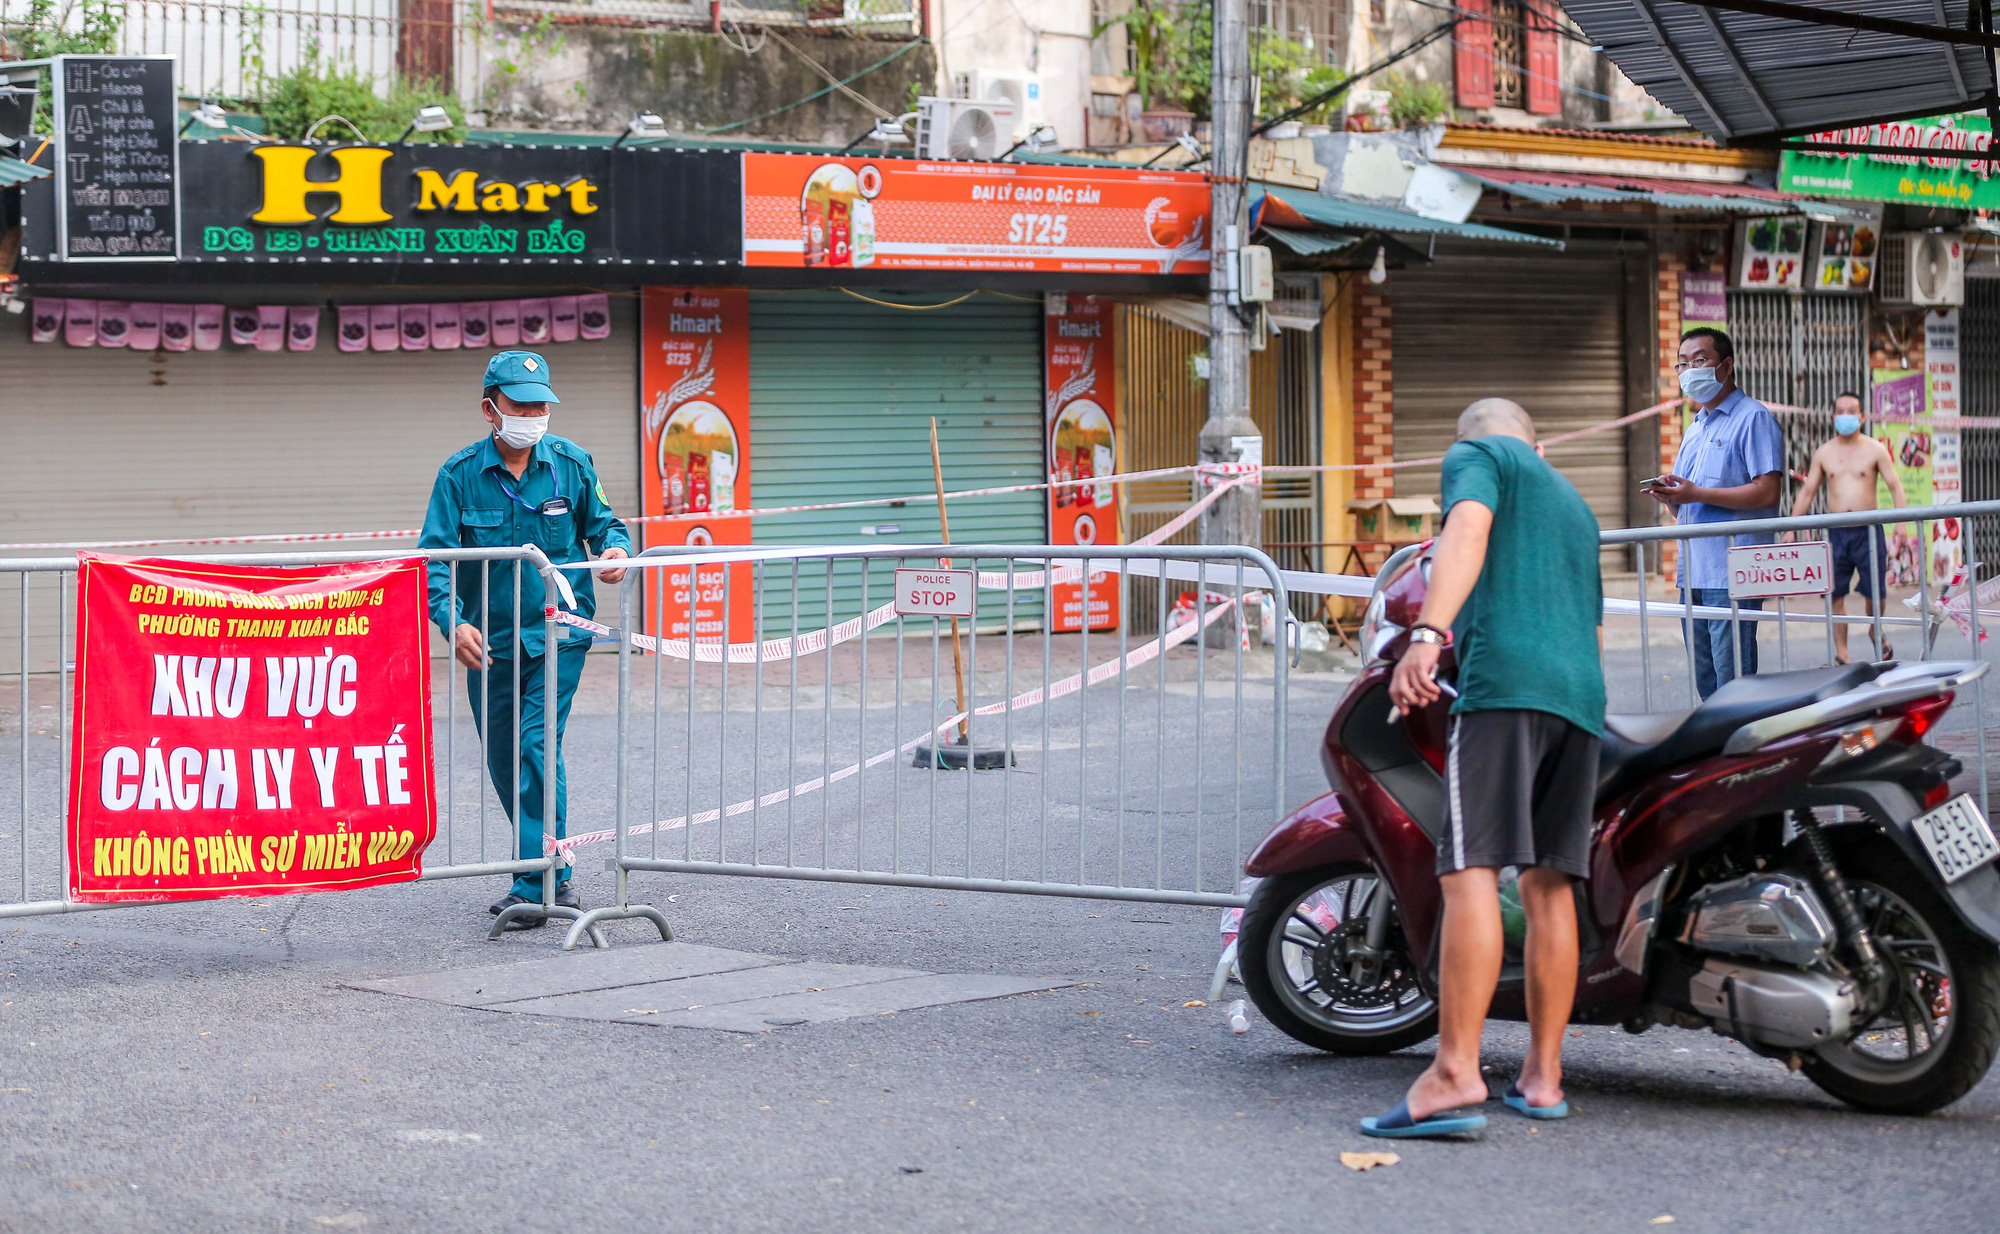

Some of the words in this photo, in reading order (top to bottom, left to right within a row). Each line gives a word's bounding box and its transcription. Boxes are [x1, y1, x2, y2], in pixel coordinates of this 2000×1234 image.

[251, 145, 394, 225] H
[416, 168, 598, 215] Mart
[972, 185, 995, 204] ĐẠI
[997, 182, 1013, 200] LÝ
[1014, 187, 1043, 205] GẠO
[1045, 185, 1074, 207] ĐẶC
[1075, 184, 1101, 204] SẢN
[323, 228, 425, 252] THANH
[435, 222, 518, 253] XUÂN
[527, 219, 586, 253] BẮC
[1008, 212, 1068, 244] ST25
[670, 312, 723, 334] Hmart
[1058, 318, 1103, 338] Hmart
[666, 352, 692, 366] ST25
[1754, 551, 1799, 561] C.A.H.N
[916, 575, 951, 584] POLICE
[1735, 564, 1787, 585] DỪNG
[1790, 565, 1822, 584] LẠI
[129, 583, 168, 605] BCĐ
[172, 585, 227, 608] PHÒNG
[328, 588, 385, 608] COVID-19
[910, 590, 957, 606] STOP
[138, 612, 221, 637] PHƯỜNG
[227, 618, 286, 638] THANH
[288, 614, 333, 638] XUÂN
[334, 611, 370, 636] BẮC
[151, 653, 250, 719] KHU
[264, 647, 358, 728] VỰC
[100, 737, 239, 811] CÁCH
[250, 748, 295, 810] LY
[309, 746, 339, 808] Y
[353, 724, 411, 806] TẾ
[93, 829, 190, 877] KHÔNG
[193, 828, 256, 881] PHẬN
[260, 830, 299, 879] SỰ
[301, 822, 363, 871] MIỄN
[366, 825, 416, 866] VÀO
